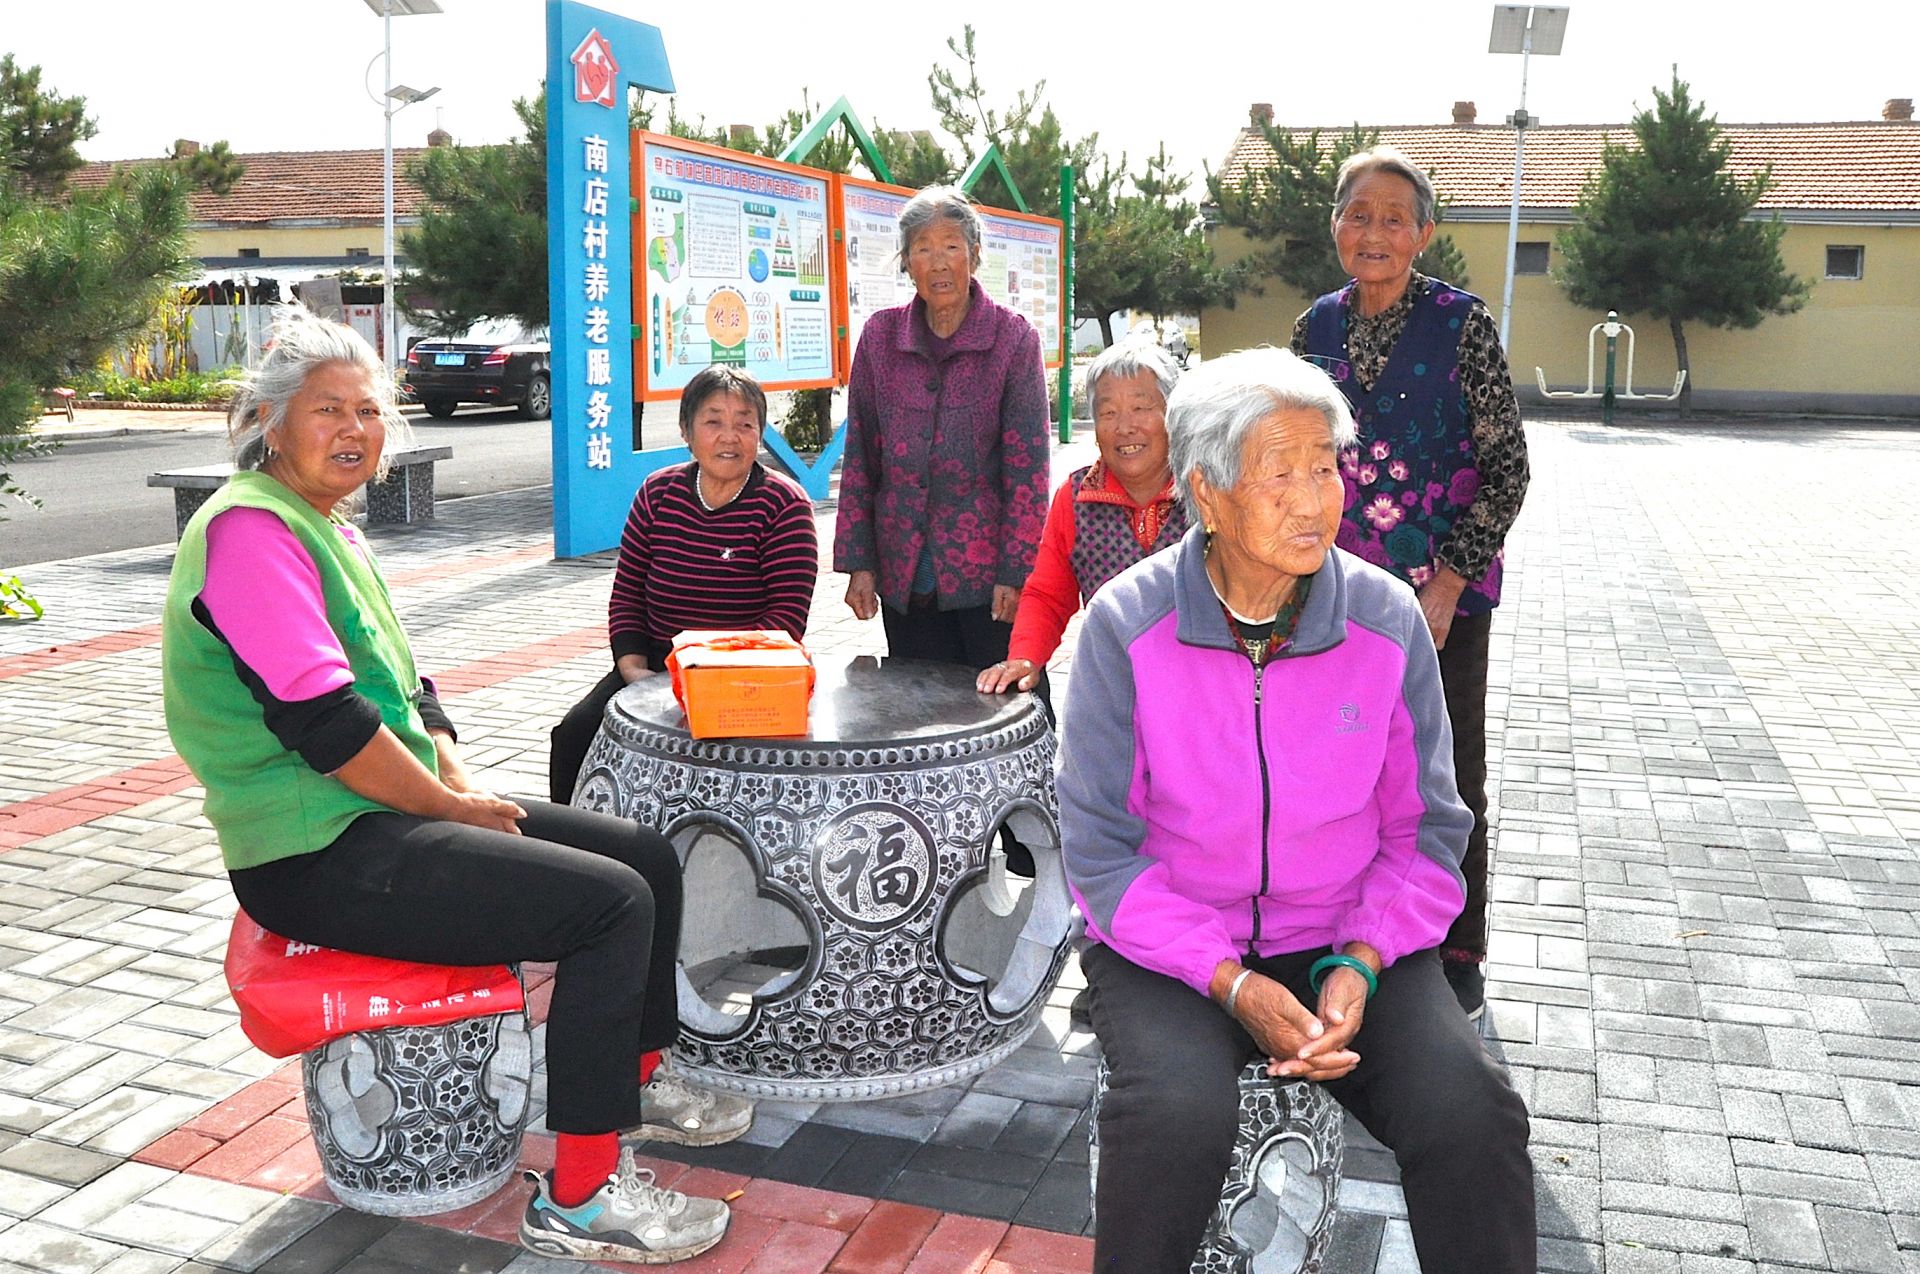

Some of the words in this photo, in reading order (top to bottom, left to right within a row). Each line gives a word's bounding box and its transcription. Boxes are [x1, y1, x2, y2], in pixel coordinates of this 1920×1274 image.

[582, 133, 612, 470] 南店村养老服务站
[825, 821, 919, 913] 福
